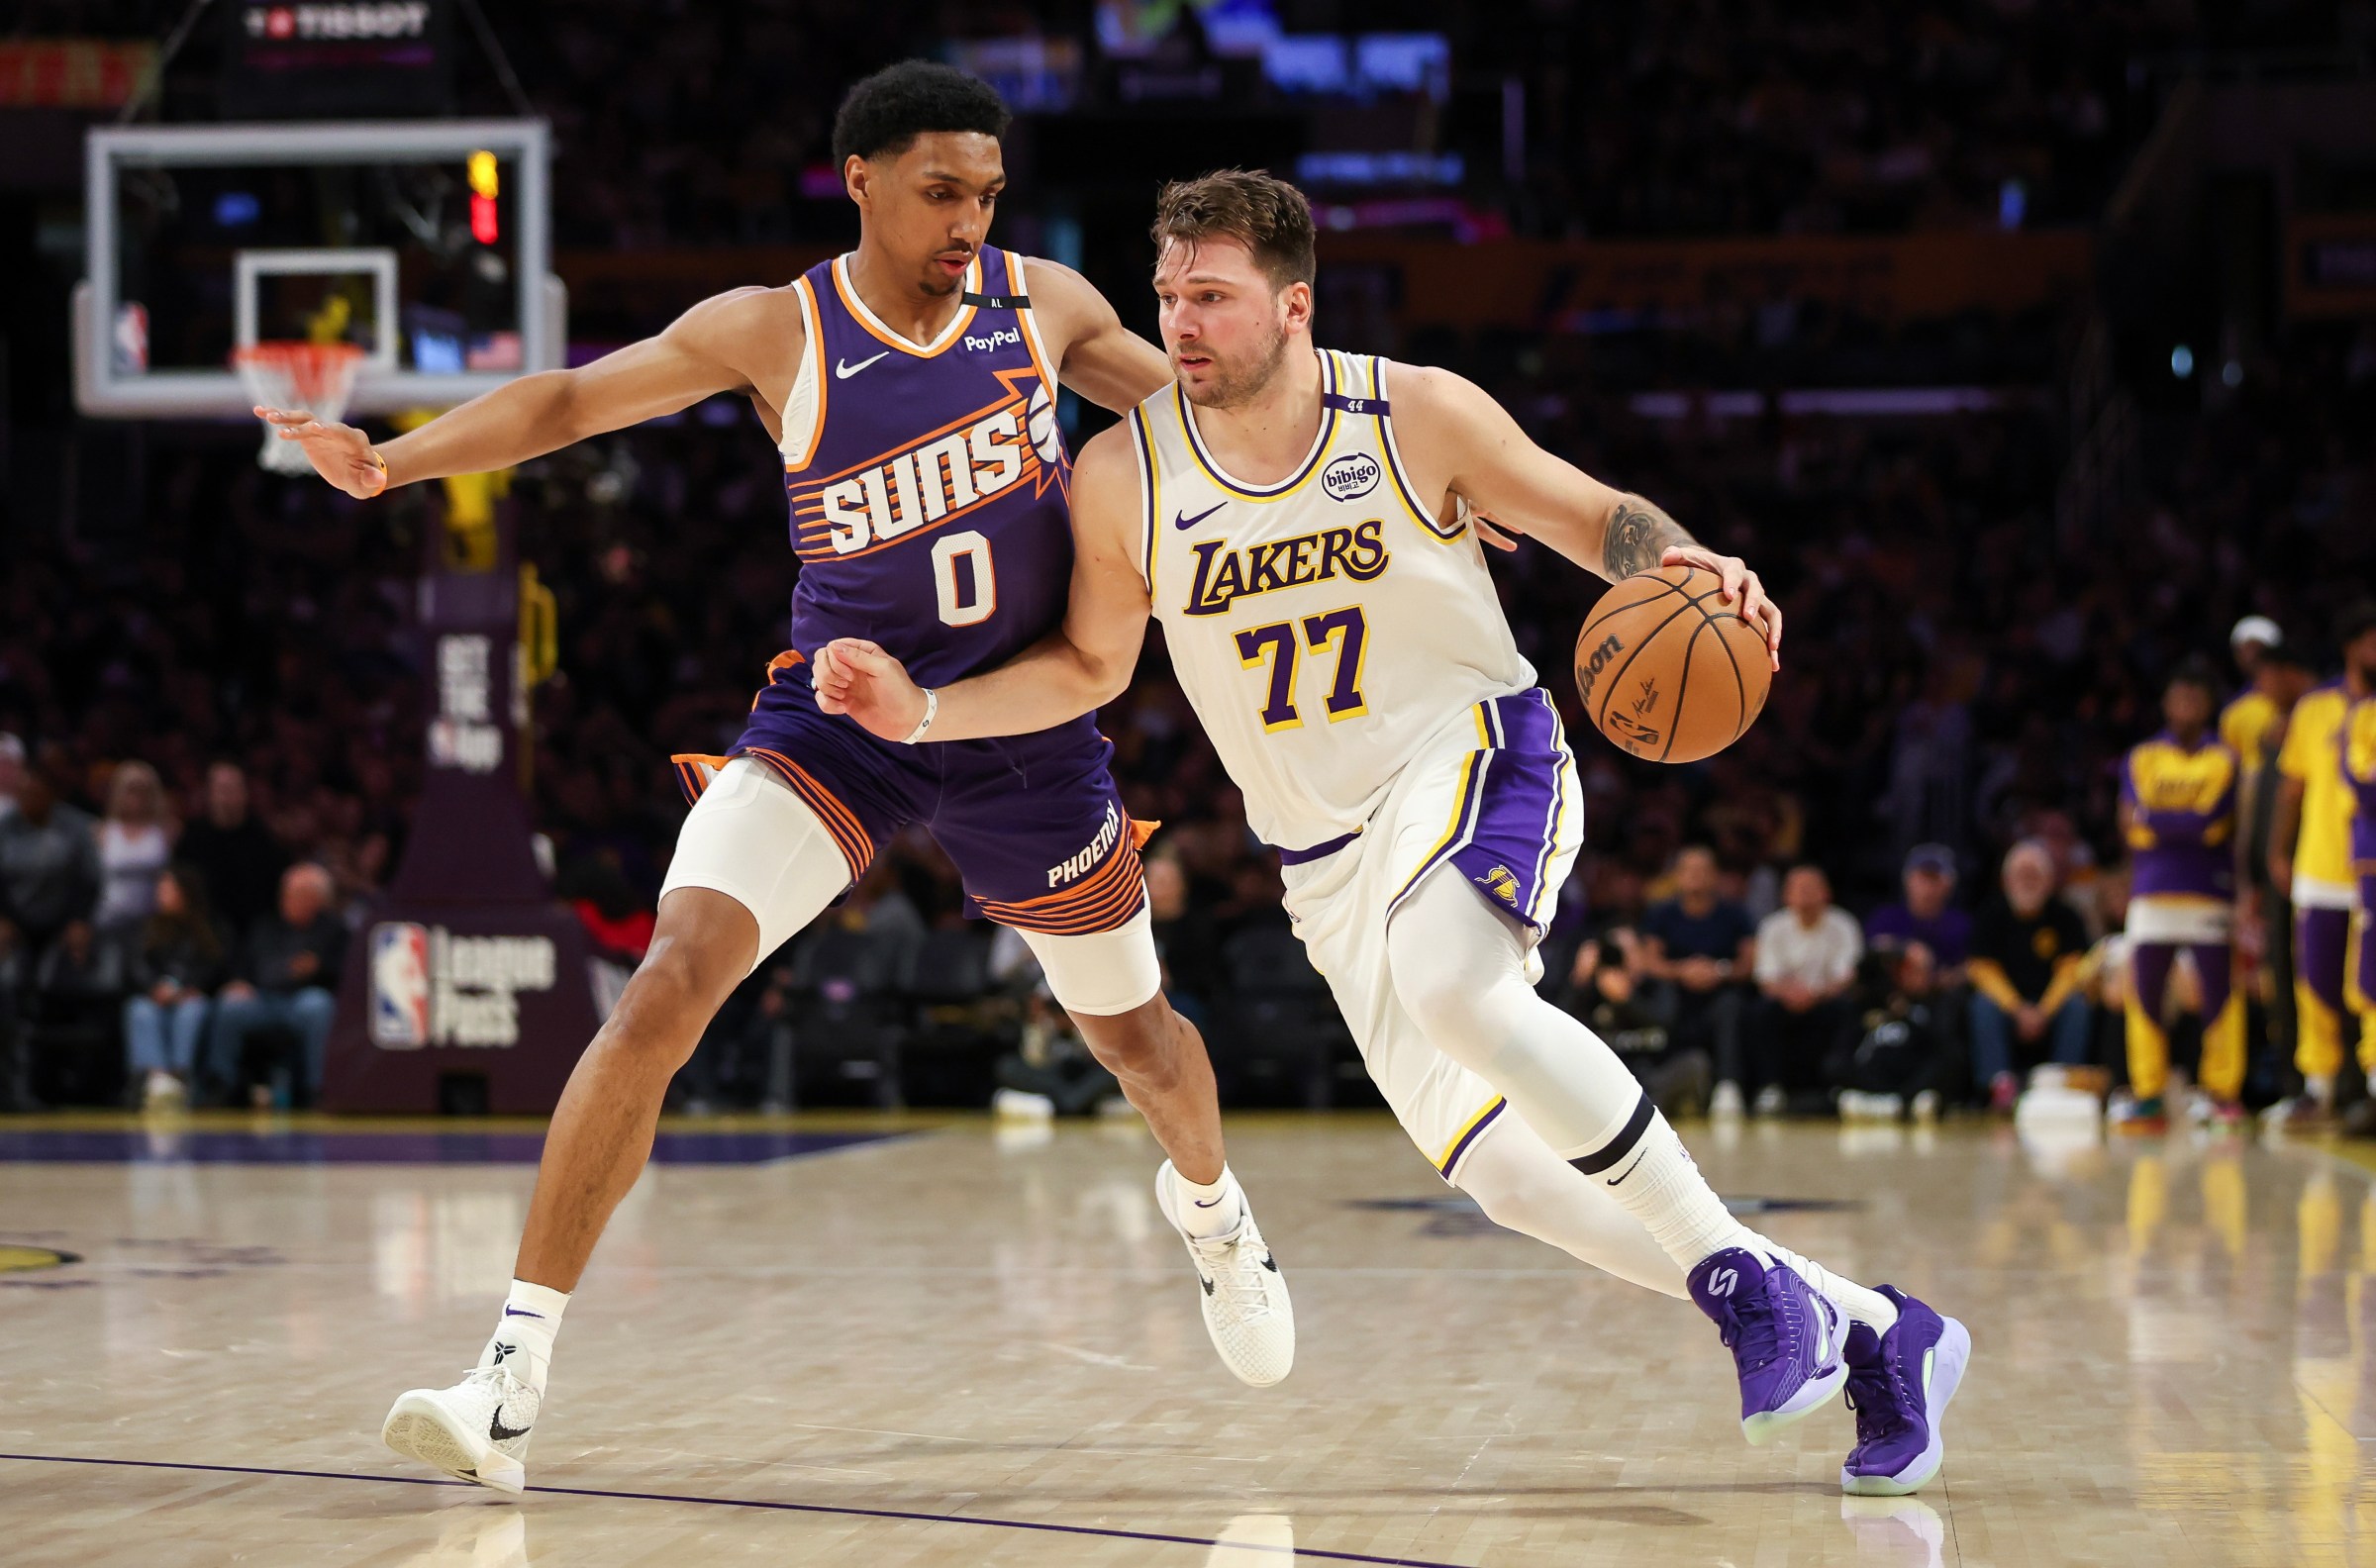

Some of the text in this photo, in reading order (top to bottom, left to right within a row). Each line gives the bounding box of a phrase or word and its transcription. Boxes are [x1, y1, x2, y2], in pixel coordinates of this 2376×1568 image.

[991, 298, 1004, 308] AL
[964, 327, 1021, 352] PayPal
[1347, 400, 1364, 412] 44
[822, 410, 1023, 555] SUNS
[1326, 465, 1377, 488] bibigo
[931, 530, 997, 628] 0
[1181, 518, 1393, 618] LAKERS
[1231, 603, 1371, 735] 77
